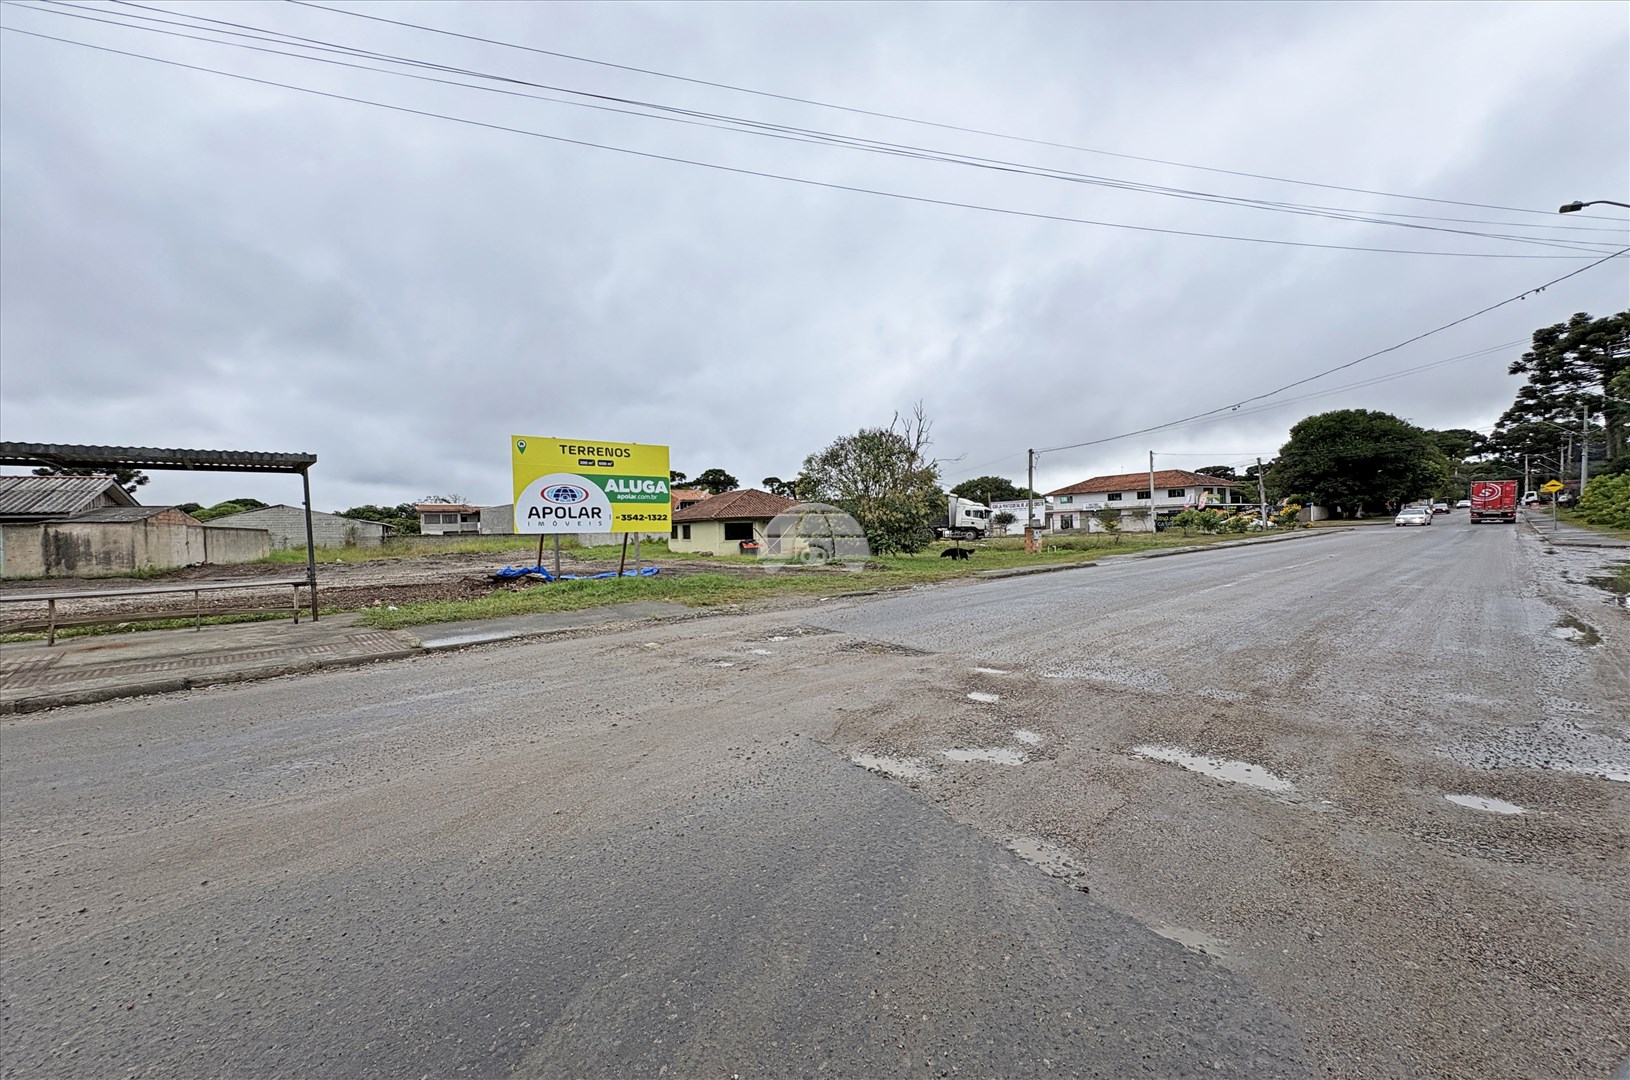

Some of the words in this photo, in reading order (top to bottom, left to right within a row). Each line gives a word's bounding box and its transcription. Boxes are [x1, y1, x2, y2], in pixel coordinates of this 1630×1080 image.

[559, 444, 631, 458] TERRENOS
[604, 479, 669, 494] ALUGA
[616, 493, 658, 501] apolar.com.br
[528, 506, 602, 519] APOLAR
